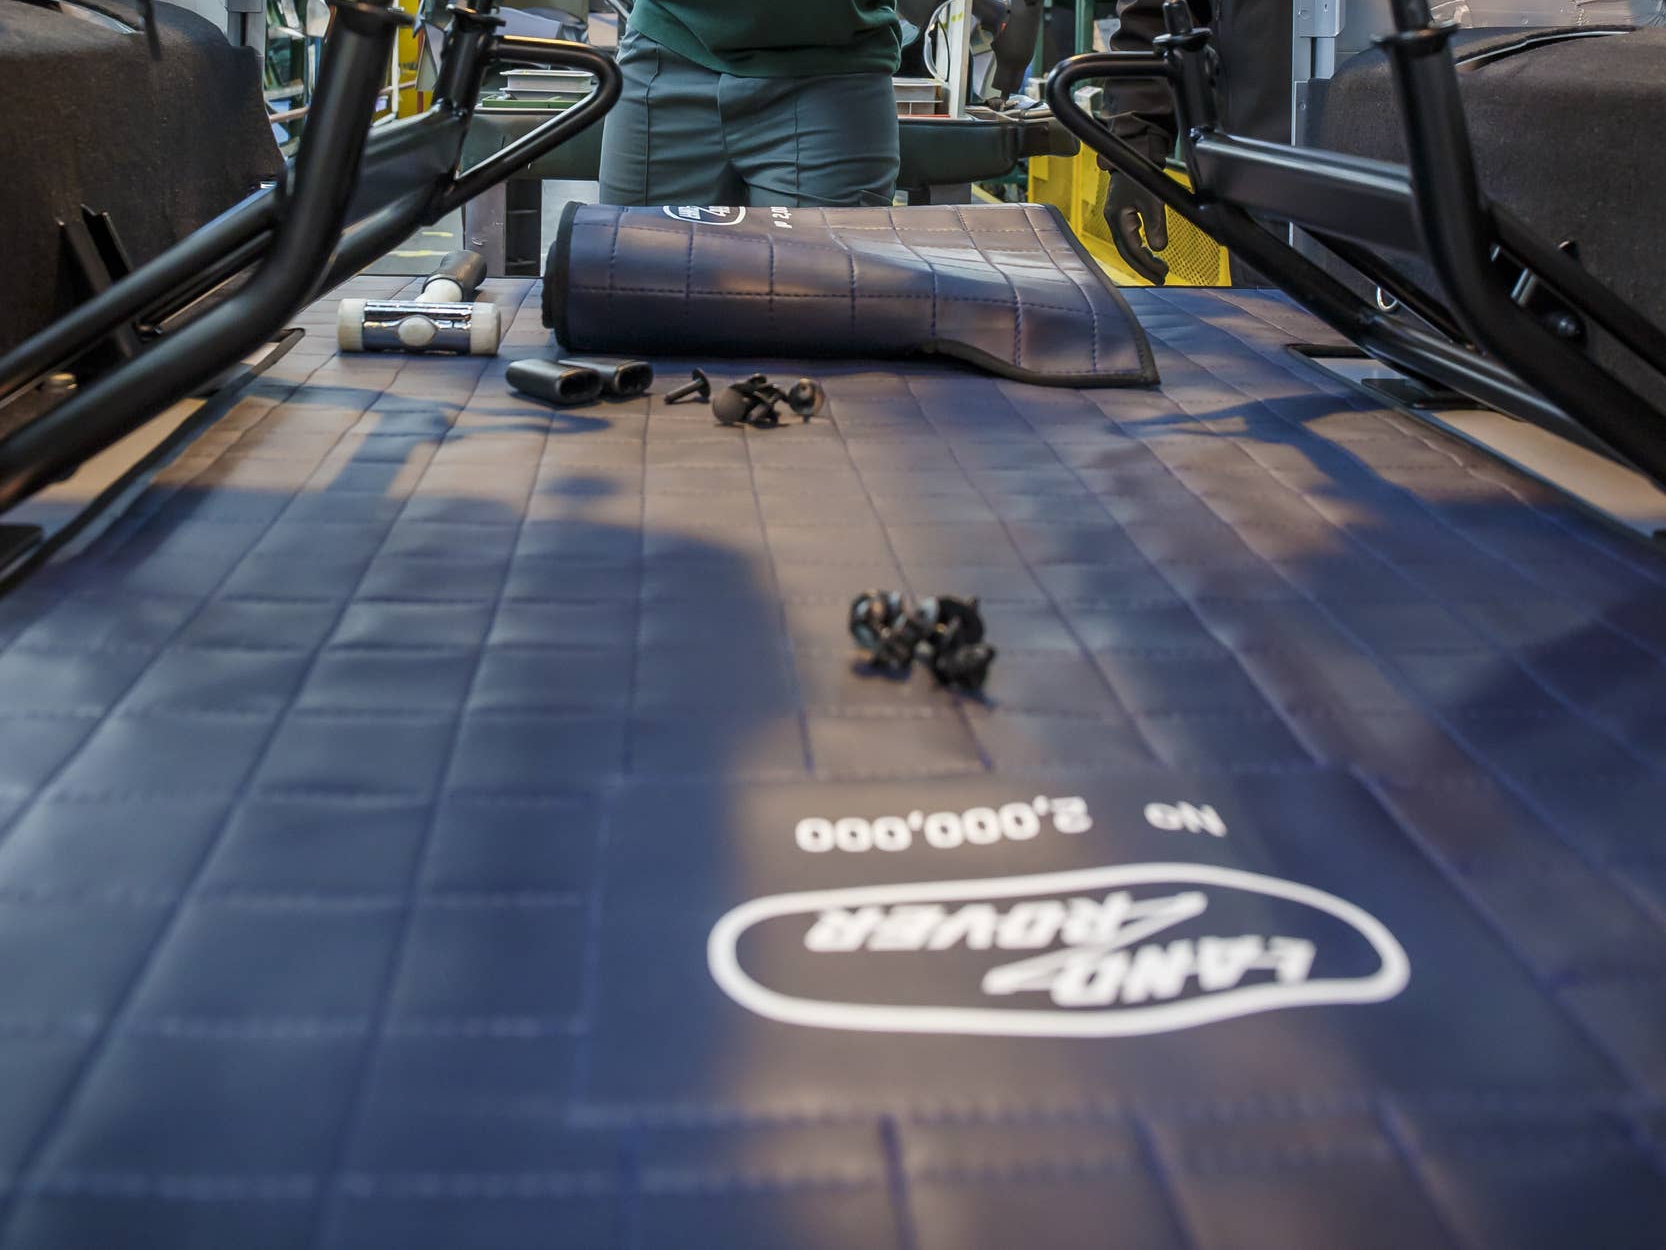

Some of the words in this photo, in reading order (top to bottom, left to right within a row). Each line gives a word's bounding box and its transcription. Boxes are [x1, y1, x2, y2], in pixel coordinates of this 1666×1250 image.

[795, 795, 1092, 852] 2,000,000
[804, 892, 1133, 951] ROVER
[1051, 936, 1316, 1006] LAND
